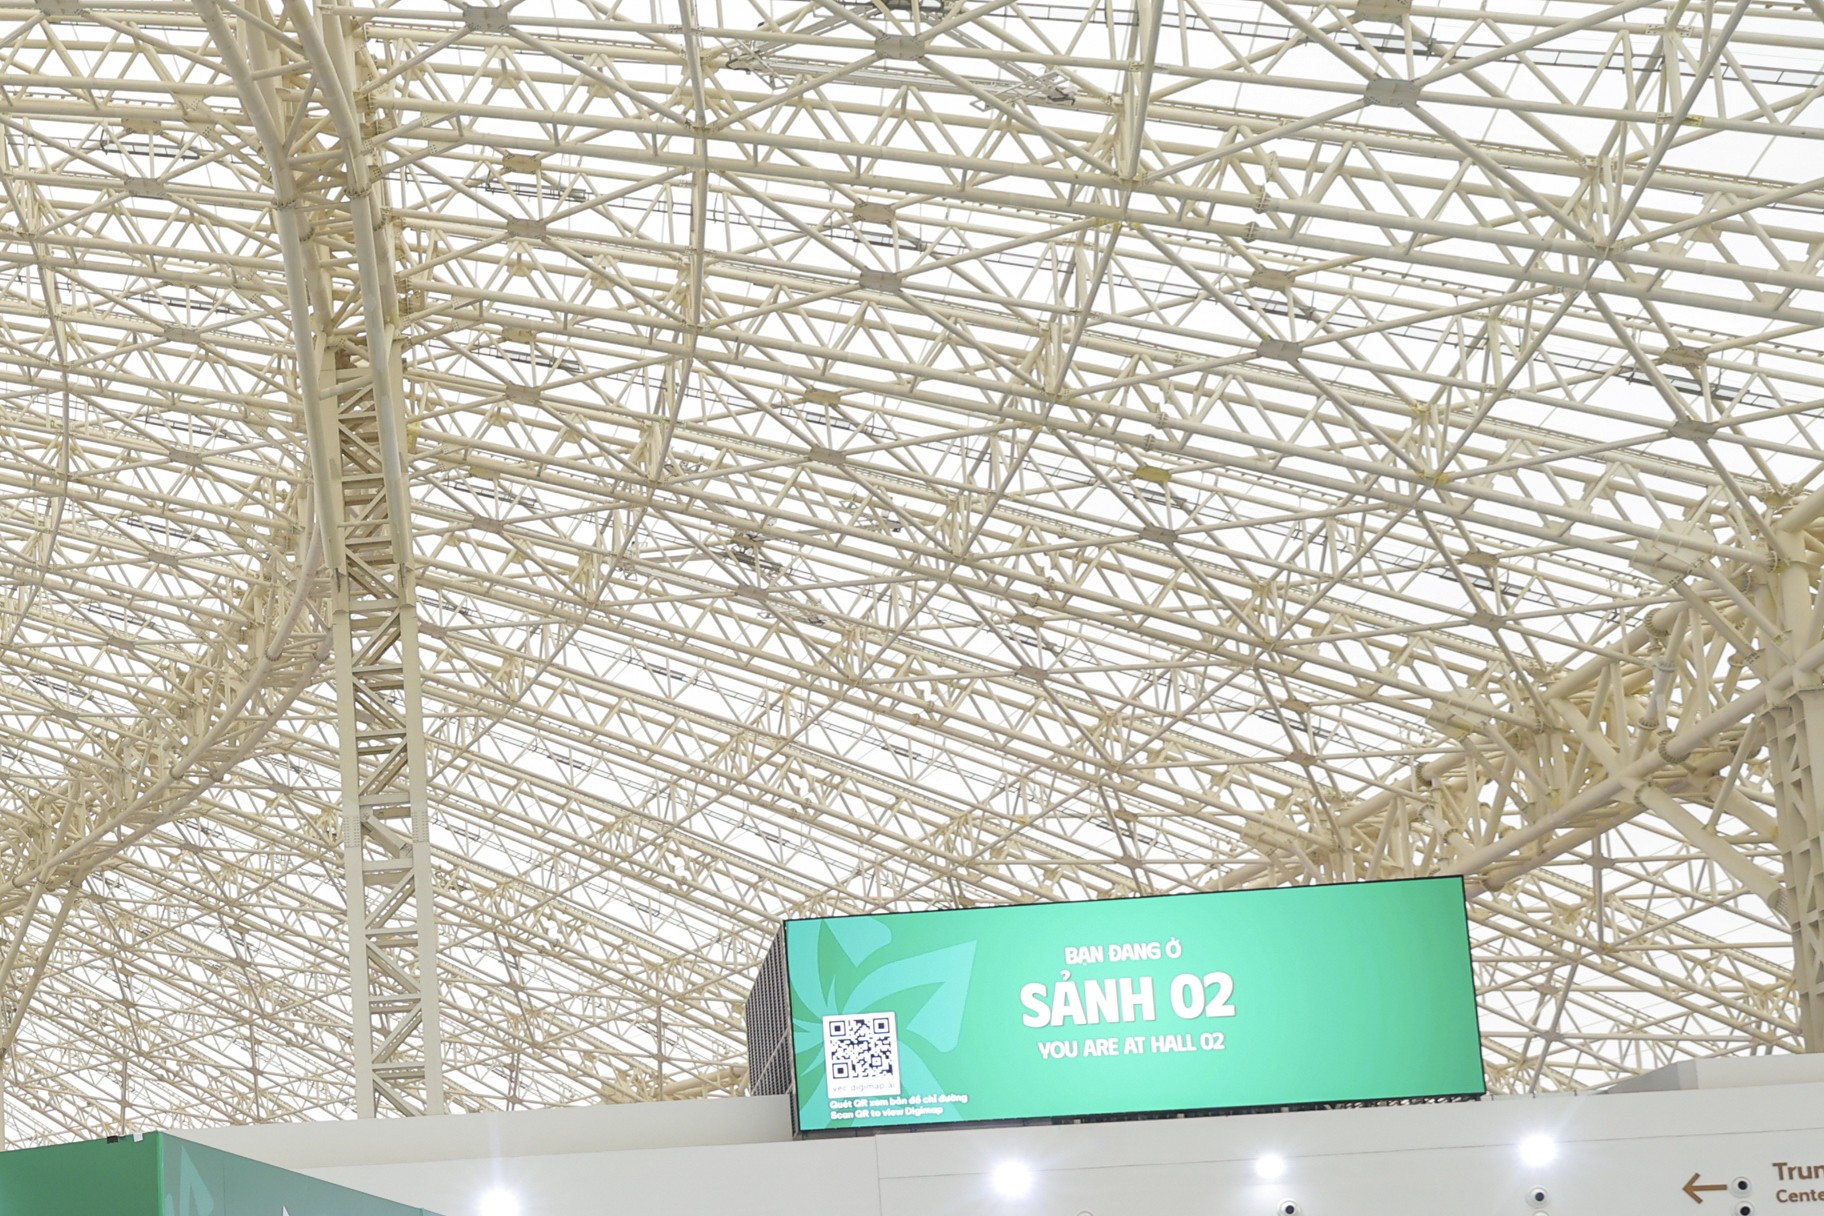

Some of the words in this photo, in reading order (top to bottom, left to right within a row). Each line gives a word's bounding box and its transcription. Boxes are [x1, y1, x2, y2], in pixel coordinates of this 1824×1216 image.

[1065, 945, 1104, 966] BẠN
[1108, 942, 1162, 962] ĐANG
[1165, 936, 1183, 959] Ở
[1020, 969, 1156, 1028] SẢNH
[1170, 971, 1236, 1020] 02
[1037, 1040, 1079, 1060] YOU
[1083, 1037, 1119, 1057] ARE
[1124, 1036, 1146, 1055] AT
[1150, 1033, 1197, 1053] HALL
[1200, 1032, 1225, 1051] 02
[829, 1098, 853, 1109] Quét
[854, 1098, 868, 1108] QR
[830, 1110, 854, 1120] Scan
[855, 1109, 869, 1119] QR
[871, 1108, 881, 1117] to
[882, 1107, 904, 1117] view
[905, 1105, 944, 1116] Digimap
